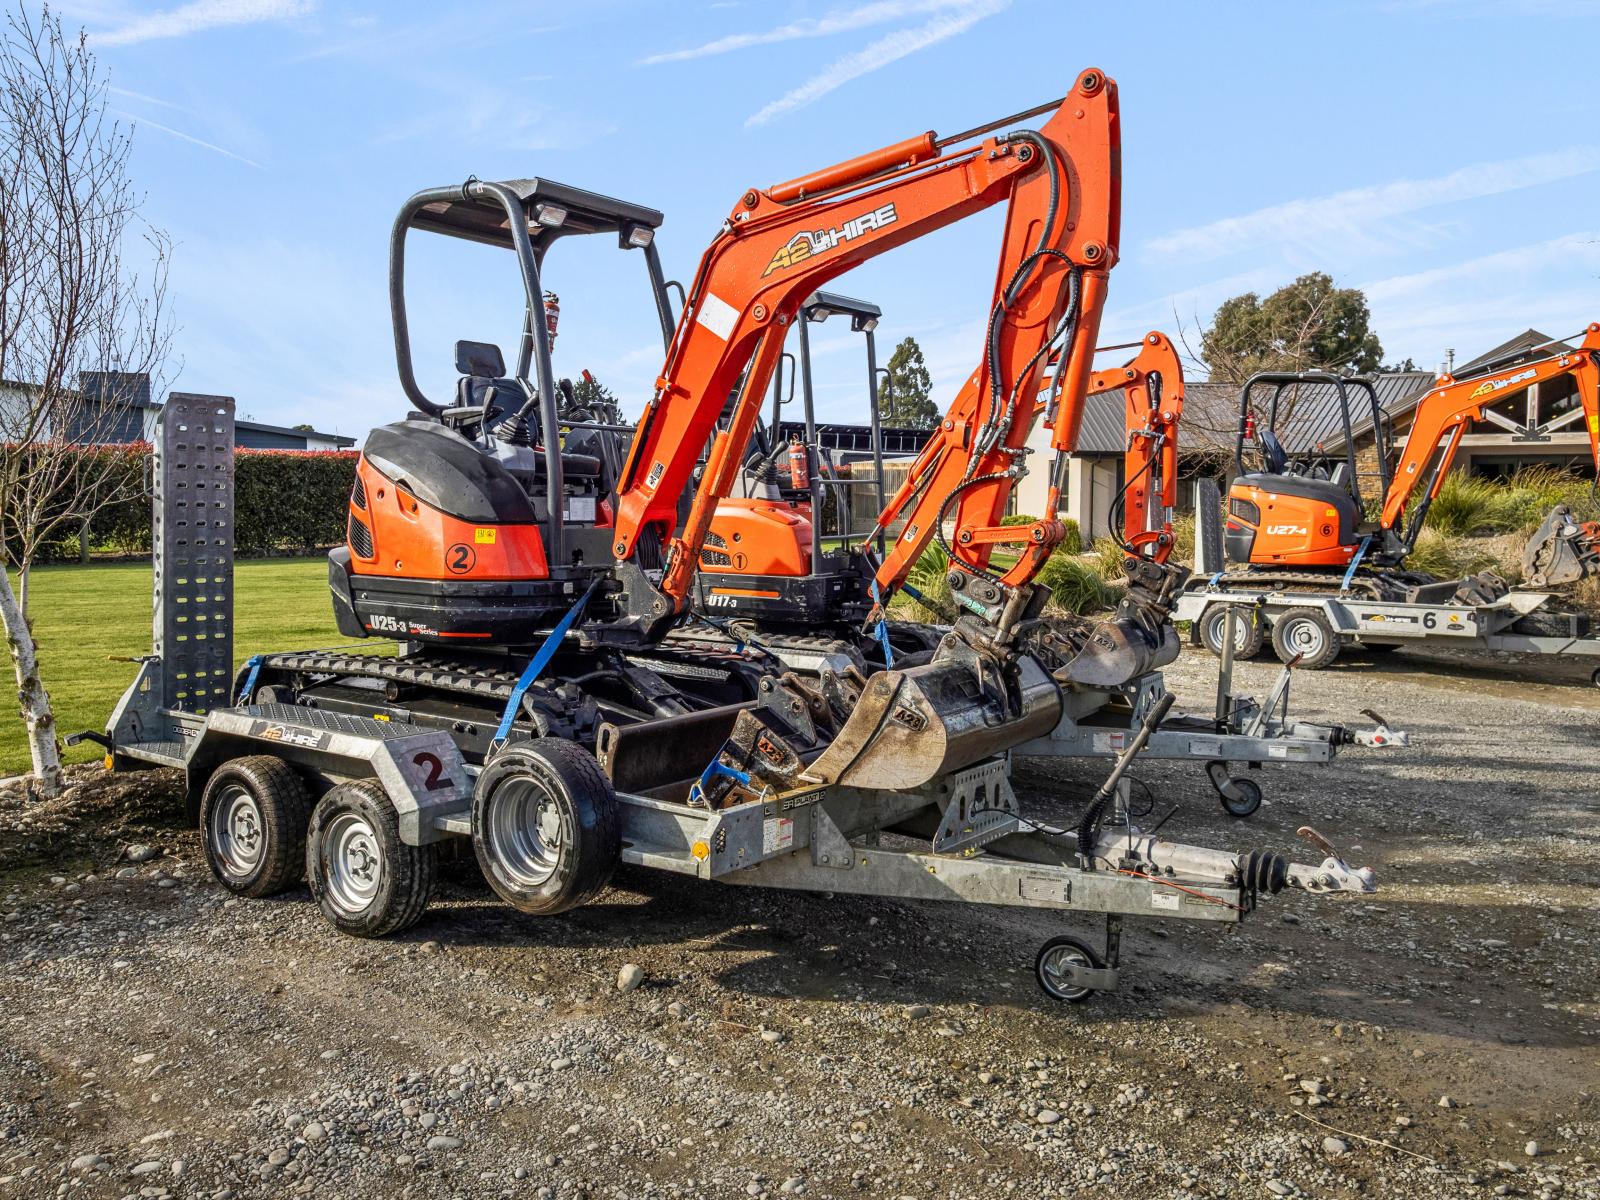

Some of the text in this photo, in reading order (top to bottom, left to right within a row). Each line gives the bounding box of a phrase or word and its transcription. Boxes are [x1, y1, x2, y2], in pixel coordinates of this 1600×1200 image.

[760, 202, 899, 279] A2 HIRE
[1266, 525, 1307, 535] U27-4
[1323, 525, 1331, 535] 6
[453, 546, 469, 569] 2
[708, 595, 737, 608] U17-3
[369, 615, 427, 632] U25-3 Super
[1423, 611, 1437, 629] 6
[419, 628, 438, 636] Series
[412, 752, 454, 791] 2
